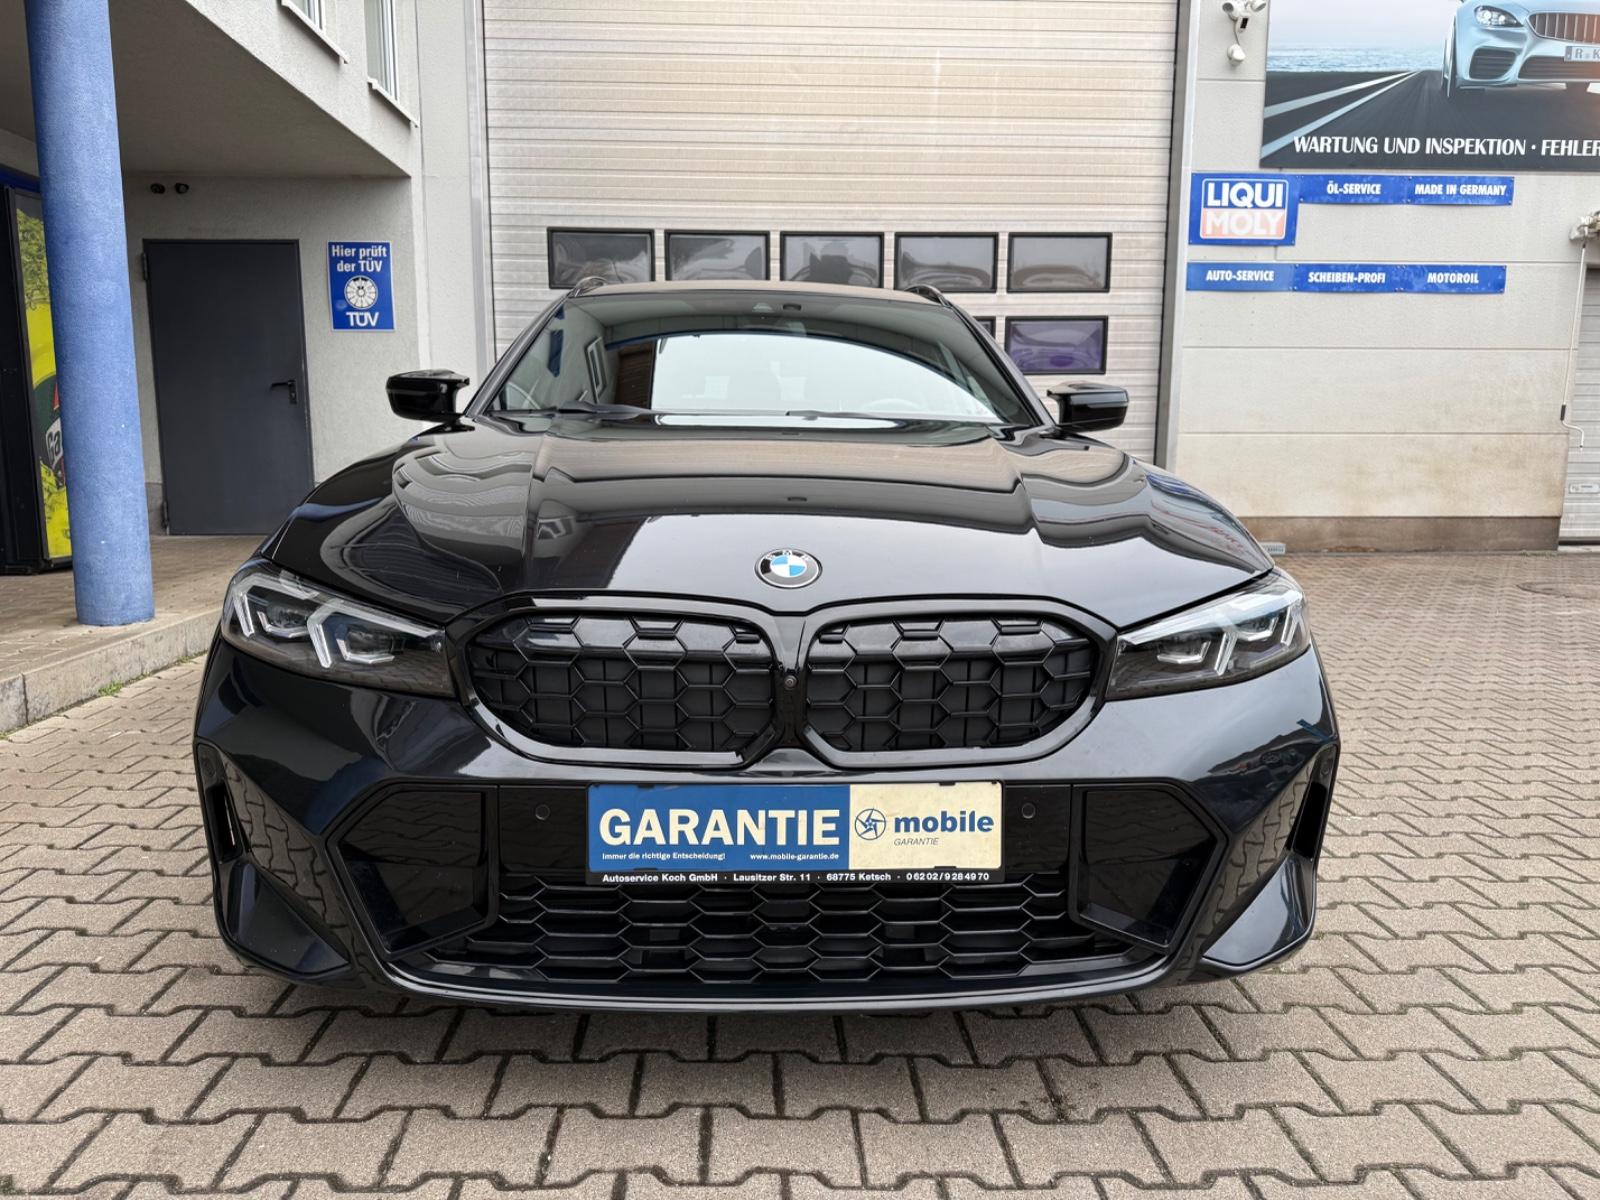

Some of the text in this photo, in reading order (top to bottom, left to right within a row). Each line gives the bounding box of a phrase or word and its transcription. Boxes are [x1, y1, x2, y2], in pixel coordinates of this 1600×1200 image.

[1293, 136, 1378, 154] WARTUNG
[1383, 137, 1420, 154] UND
[1425, 138, 1526, 155] INSPEKTION
[1207, 182, 1284, 208] LIQUI
[1327, 180, 1381, 195] ÖL-SERVICE
[1415, 184, 1507, 196] MADE IN GERMANY
[1205, 211, 1284, 235] MOLY
[331, 245, 387, 260] Hier prüft
[336, 257, 383, 272] der TÜV
[1206, 270, 1275, 282] AUTO-SERVICE
[1308, 271, 1386, 284] SCHEIBEN-PROFI
[1427, 272, 1479, 284] MOTOROIL
[345, 311, 379, 327] TÜV
[599, 808, 840, 846] GARANTIE
[894, 810, 995, 833] mobile
[894, 837, 939, 846] GARANTIE
[628, 852, 640, 860] die
[641, 852, 671, 861] richtige
[672, 852, 726, 861] Entscheidung!
[750, 852, 840, 861] www.mobile-garantie.de
[602, 874, 659, 882] Autoservice
[661, 873, 686, 882] Koch
[688, 873, 718, 882] GmbH
[733, 873, 777, 882] Lausitzer
[779, 873, 797, 882] Str.
[800, 873, 811, 881] 11
[826, 872, 856, 881] 68775
[859, 872, 891, 881] Ketsch
